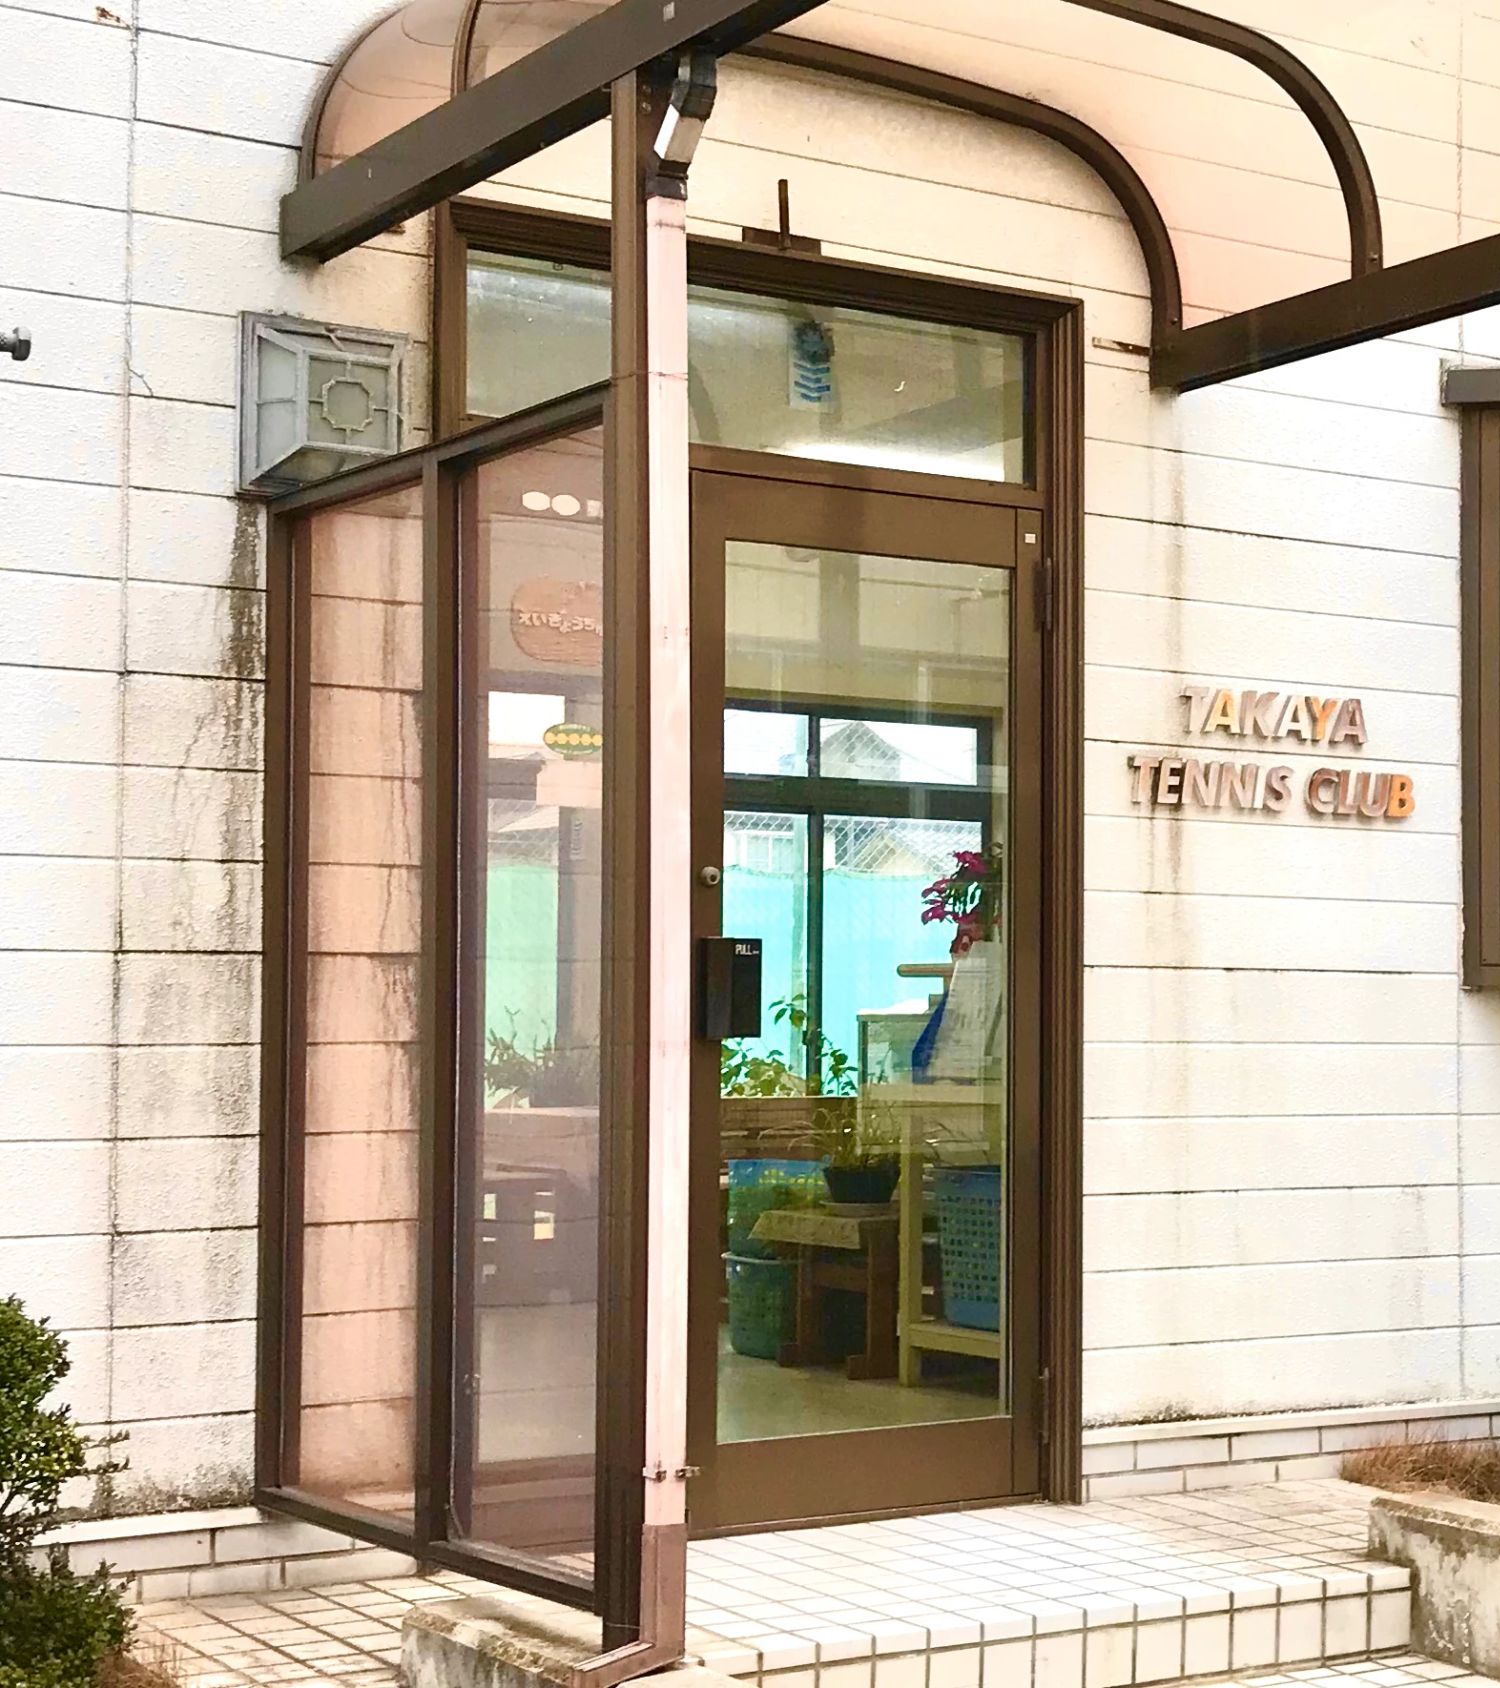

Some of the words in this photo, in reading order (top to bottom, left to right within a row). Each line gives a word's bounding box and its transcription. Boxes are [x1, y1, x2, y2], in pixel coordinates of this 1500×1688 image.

[1179, 686, 1367, 745] TAKAYA
[1128, 756, 1294, 812] TENNIS
[1305, 767, 1416, 818] CLUB
